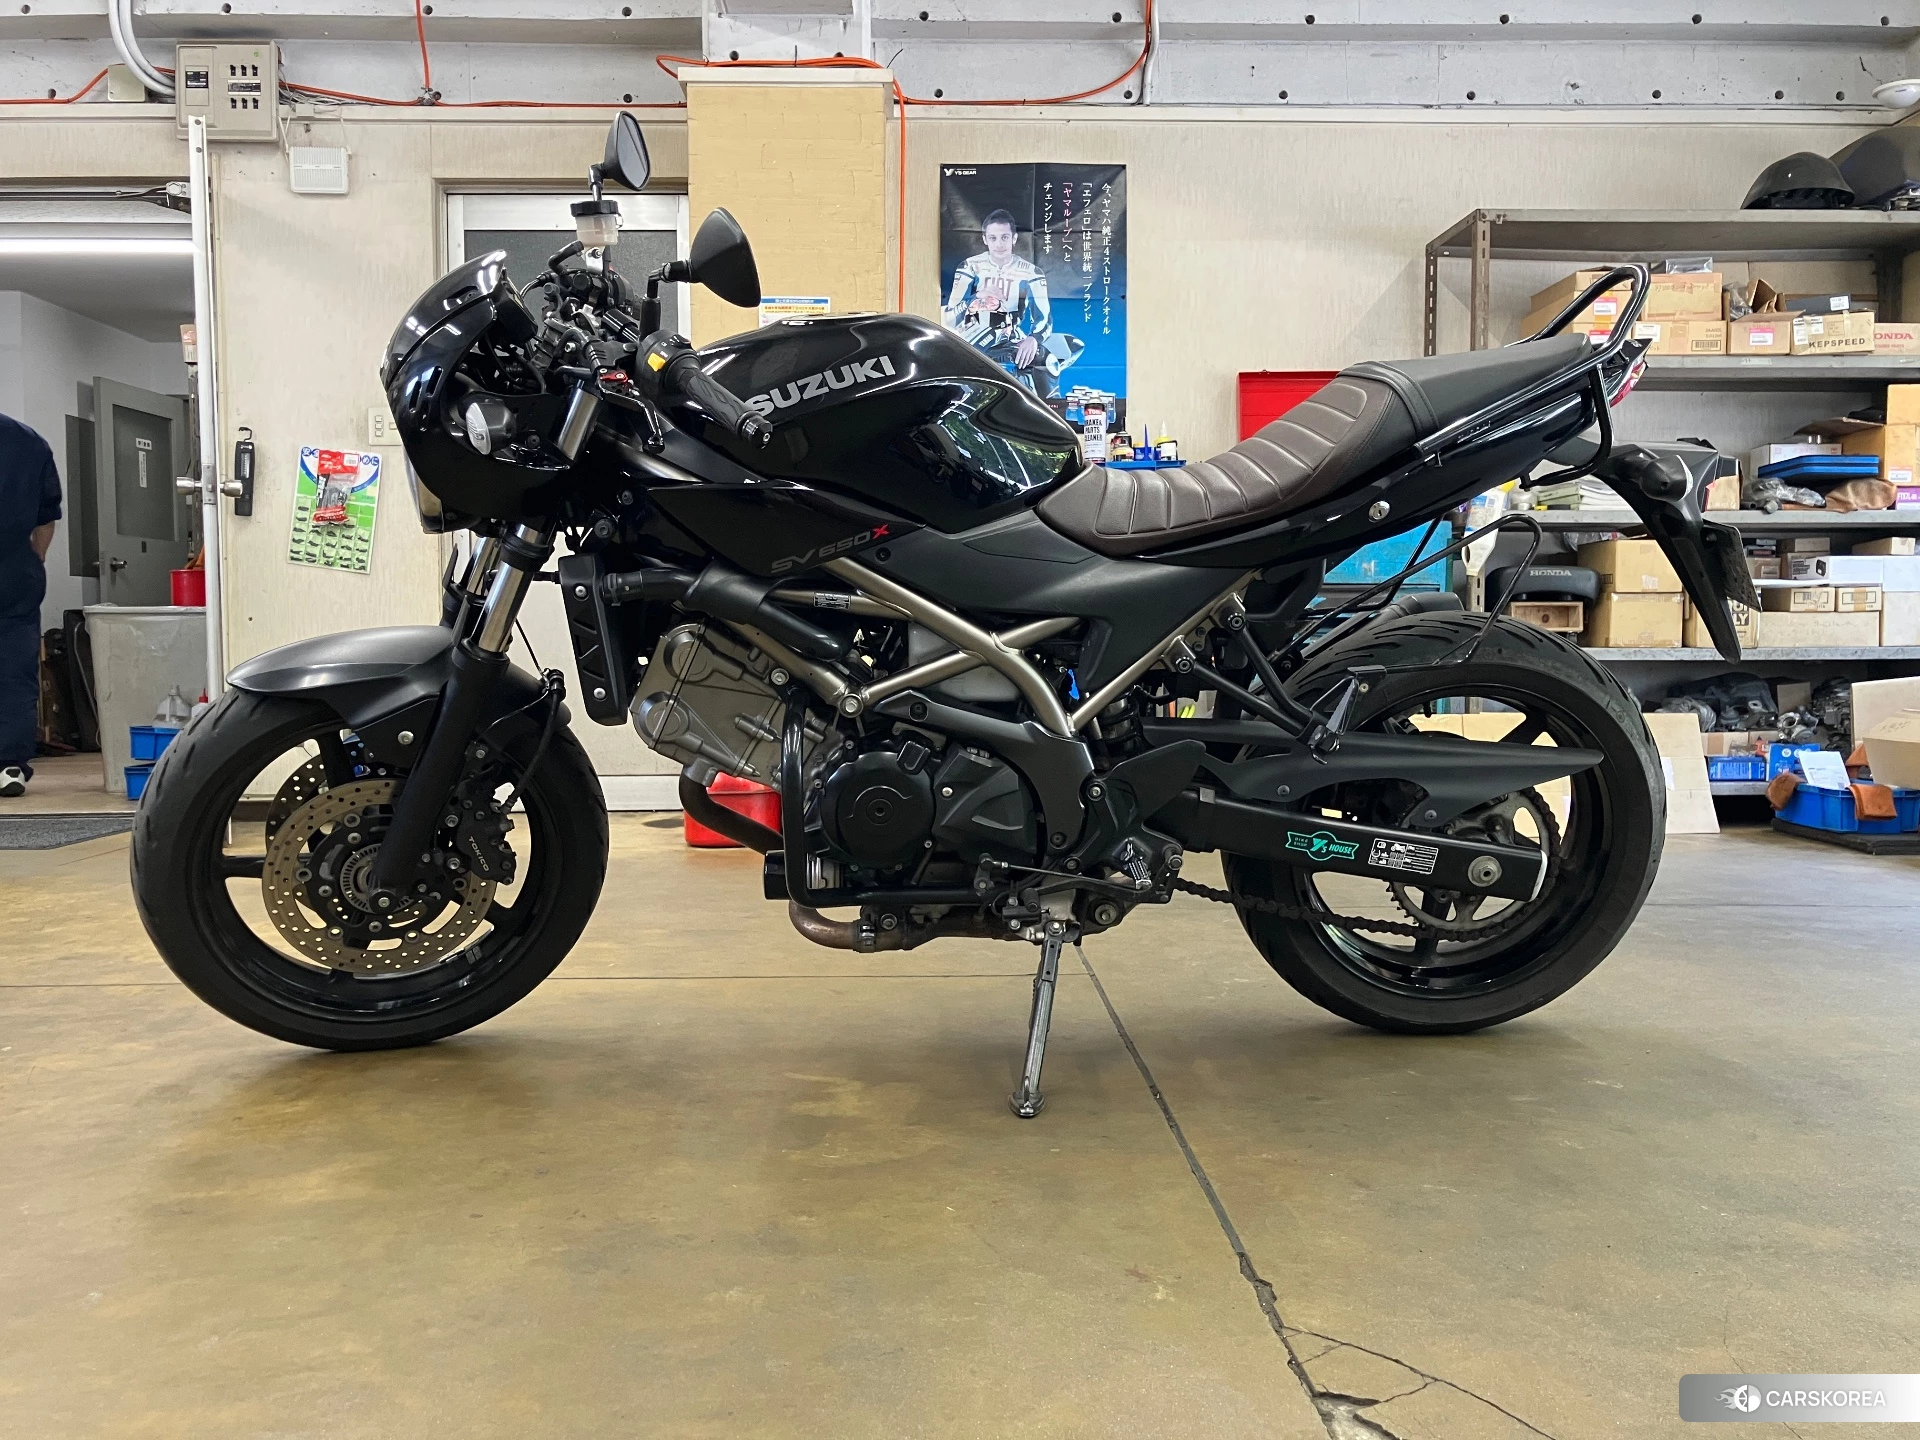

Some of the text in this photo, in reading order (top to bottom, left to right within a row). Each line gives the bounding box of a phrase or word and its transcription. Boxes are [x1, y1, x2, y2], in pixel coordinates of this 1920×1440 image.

[1043, 182, 1053, 255] チェンジします
[1874, 332, 1914, 340] ONDA
[744, 355, 896, 418] SUZUKI
[770, 523, 889, 574] SV650X
[468, 835, 490, 872] TOKICO
[1329, 843, 1352, 854] HOUSE
